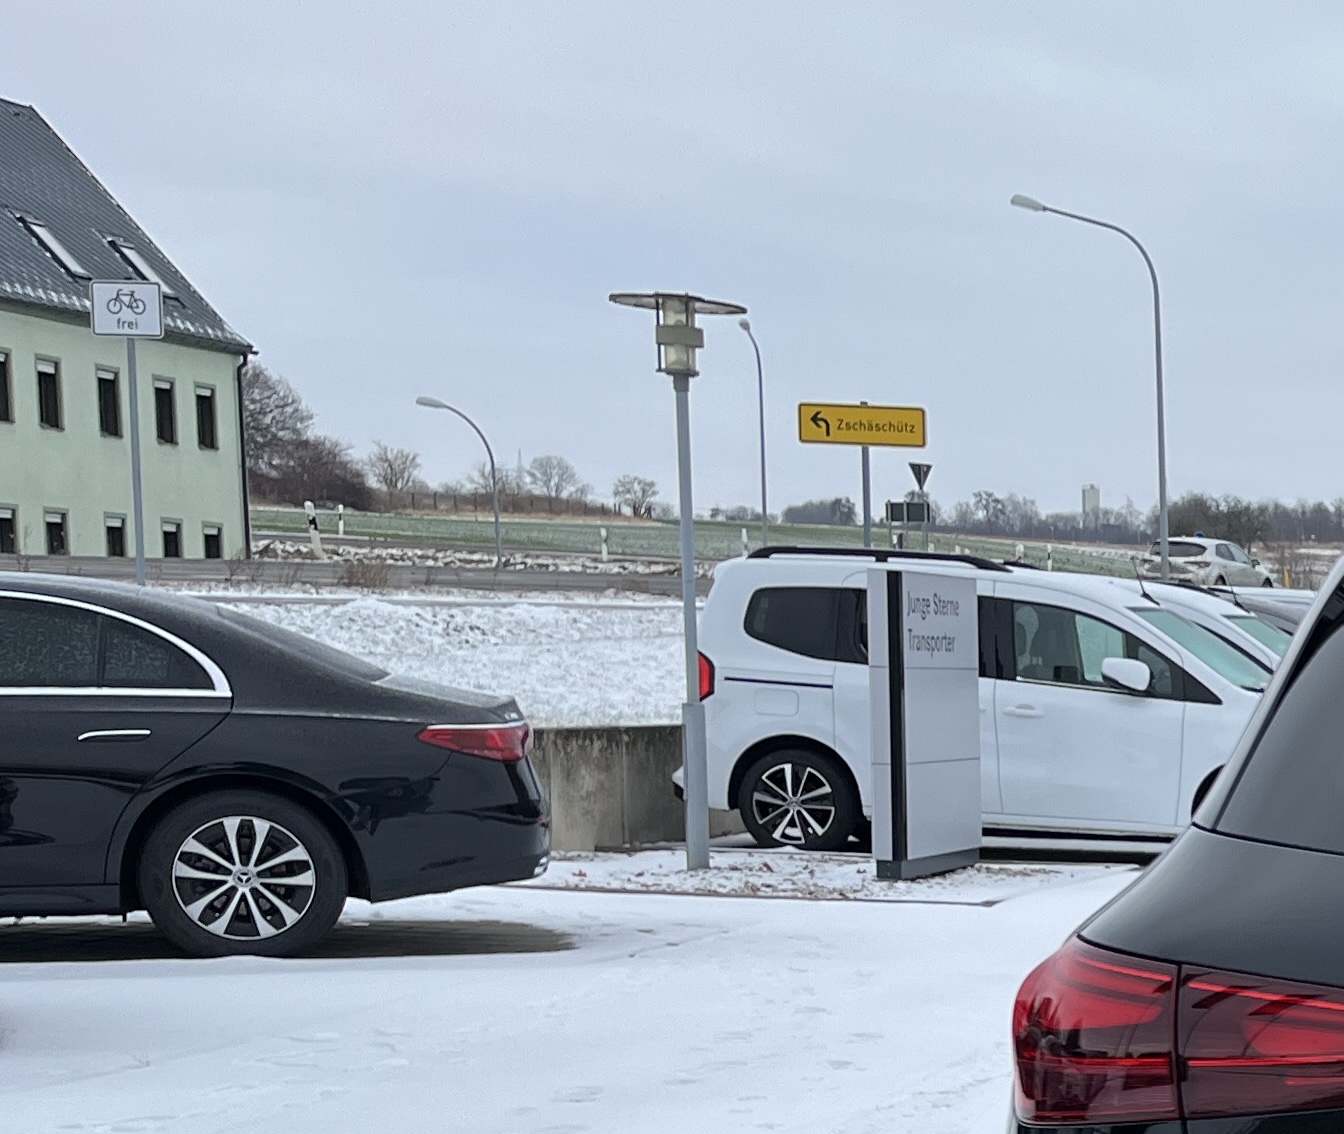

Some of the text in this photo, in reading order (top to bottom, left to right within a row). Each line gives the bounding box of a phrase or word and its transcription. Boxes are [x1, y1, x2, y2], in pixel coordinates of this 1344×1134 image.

[116, 317, 139, 330] frei
[836, 418, 917, 434] Zschäschütz
[906, 590, 960, 621] Junge Sterne
[907, 628, 956, 659] Transporter
